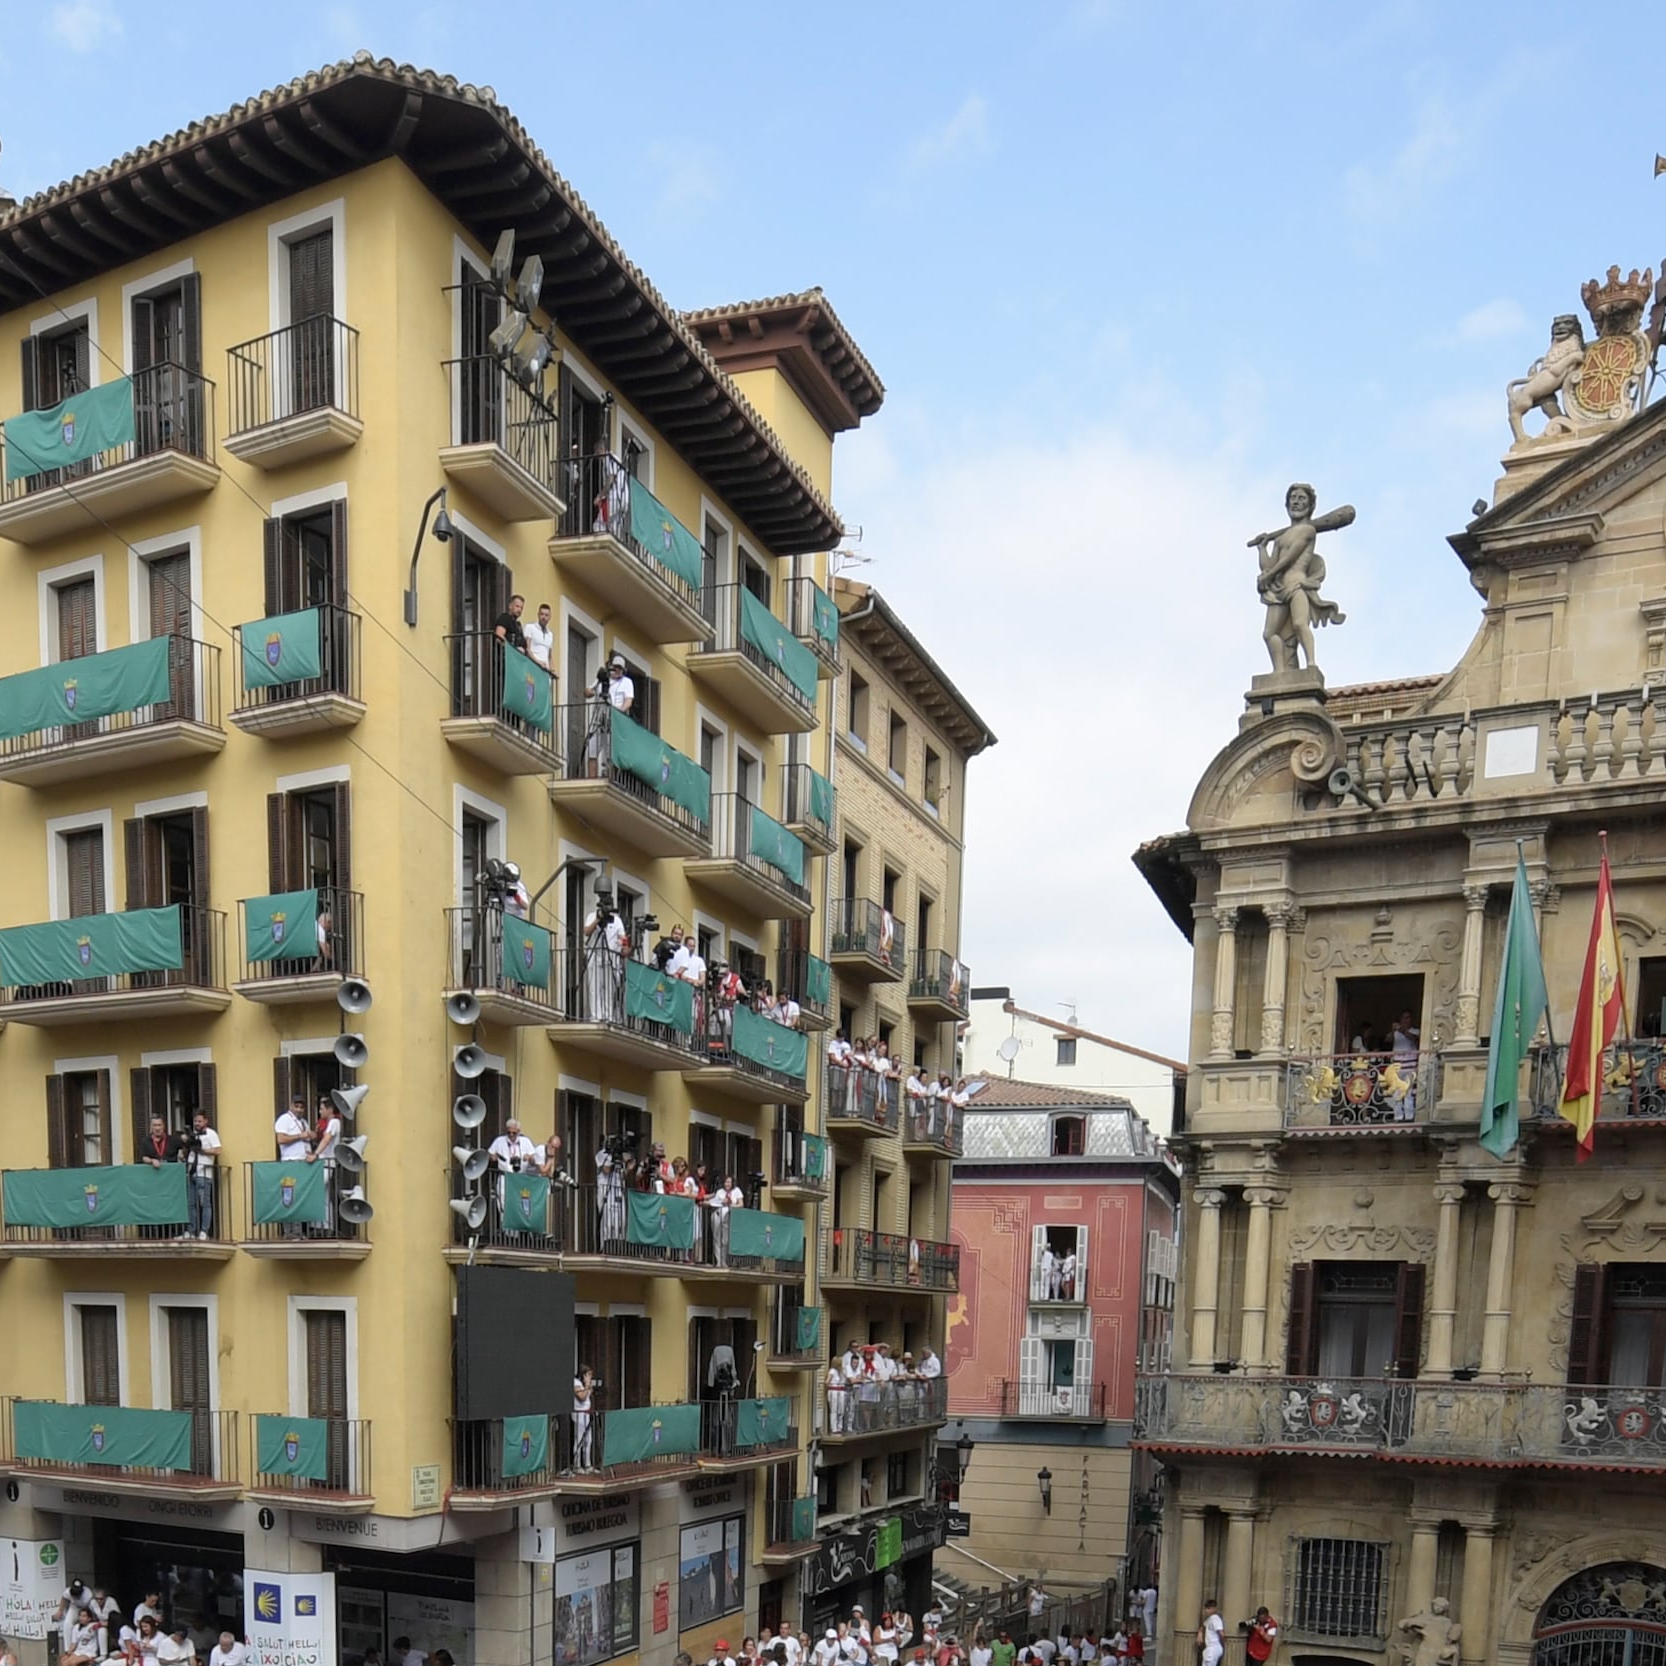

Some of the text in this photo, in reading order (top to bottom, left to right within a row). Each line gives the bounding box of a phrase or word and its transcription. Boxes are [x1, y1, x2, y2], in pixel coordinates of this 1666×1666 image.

[562, 1502, 592, 1519] OFICINA
[1077, 1454, 1092, 1553] FARMACIA
[316, 1516, 378, 1537] BIENVENUE
[566, 1512, 628, 1537] TURISMO BULEGOA
